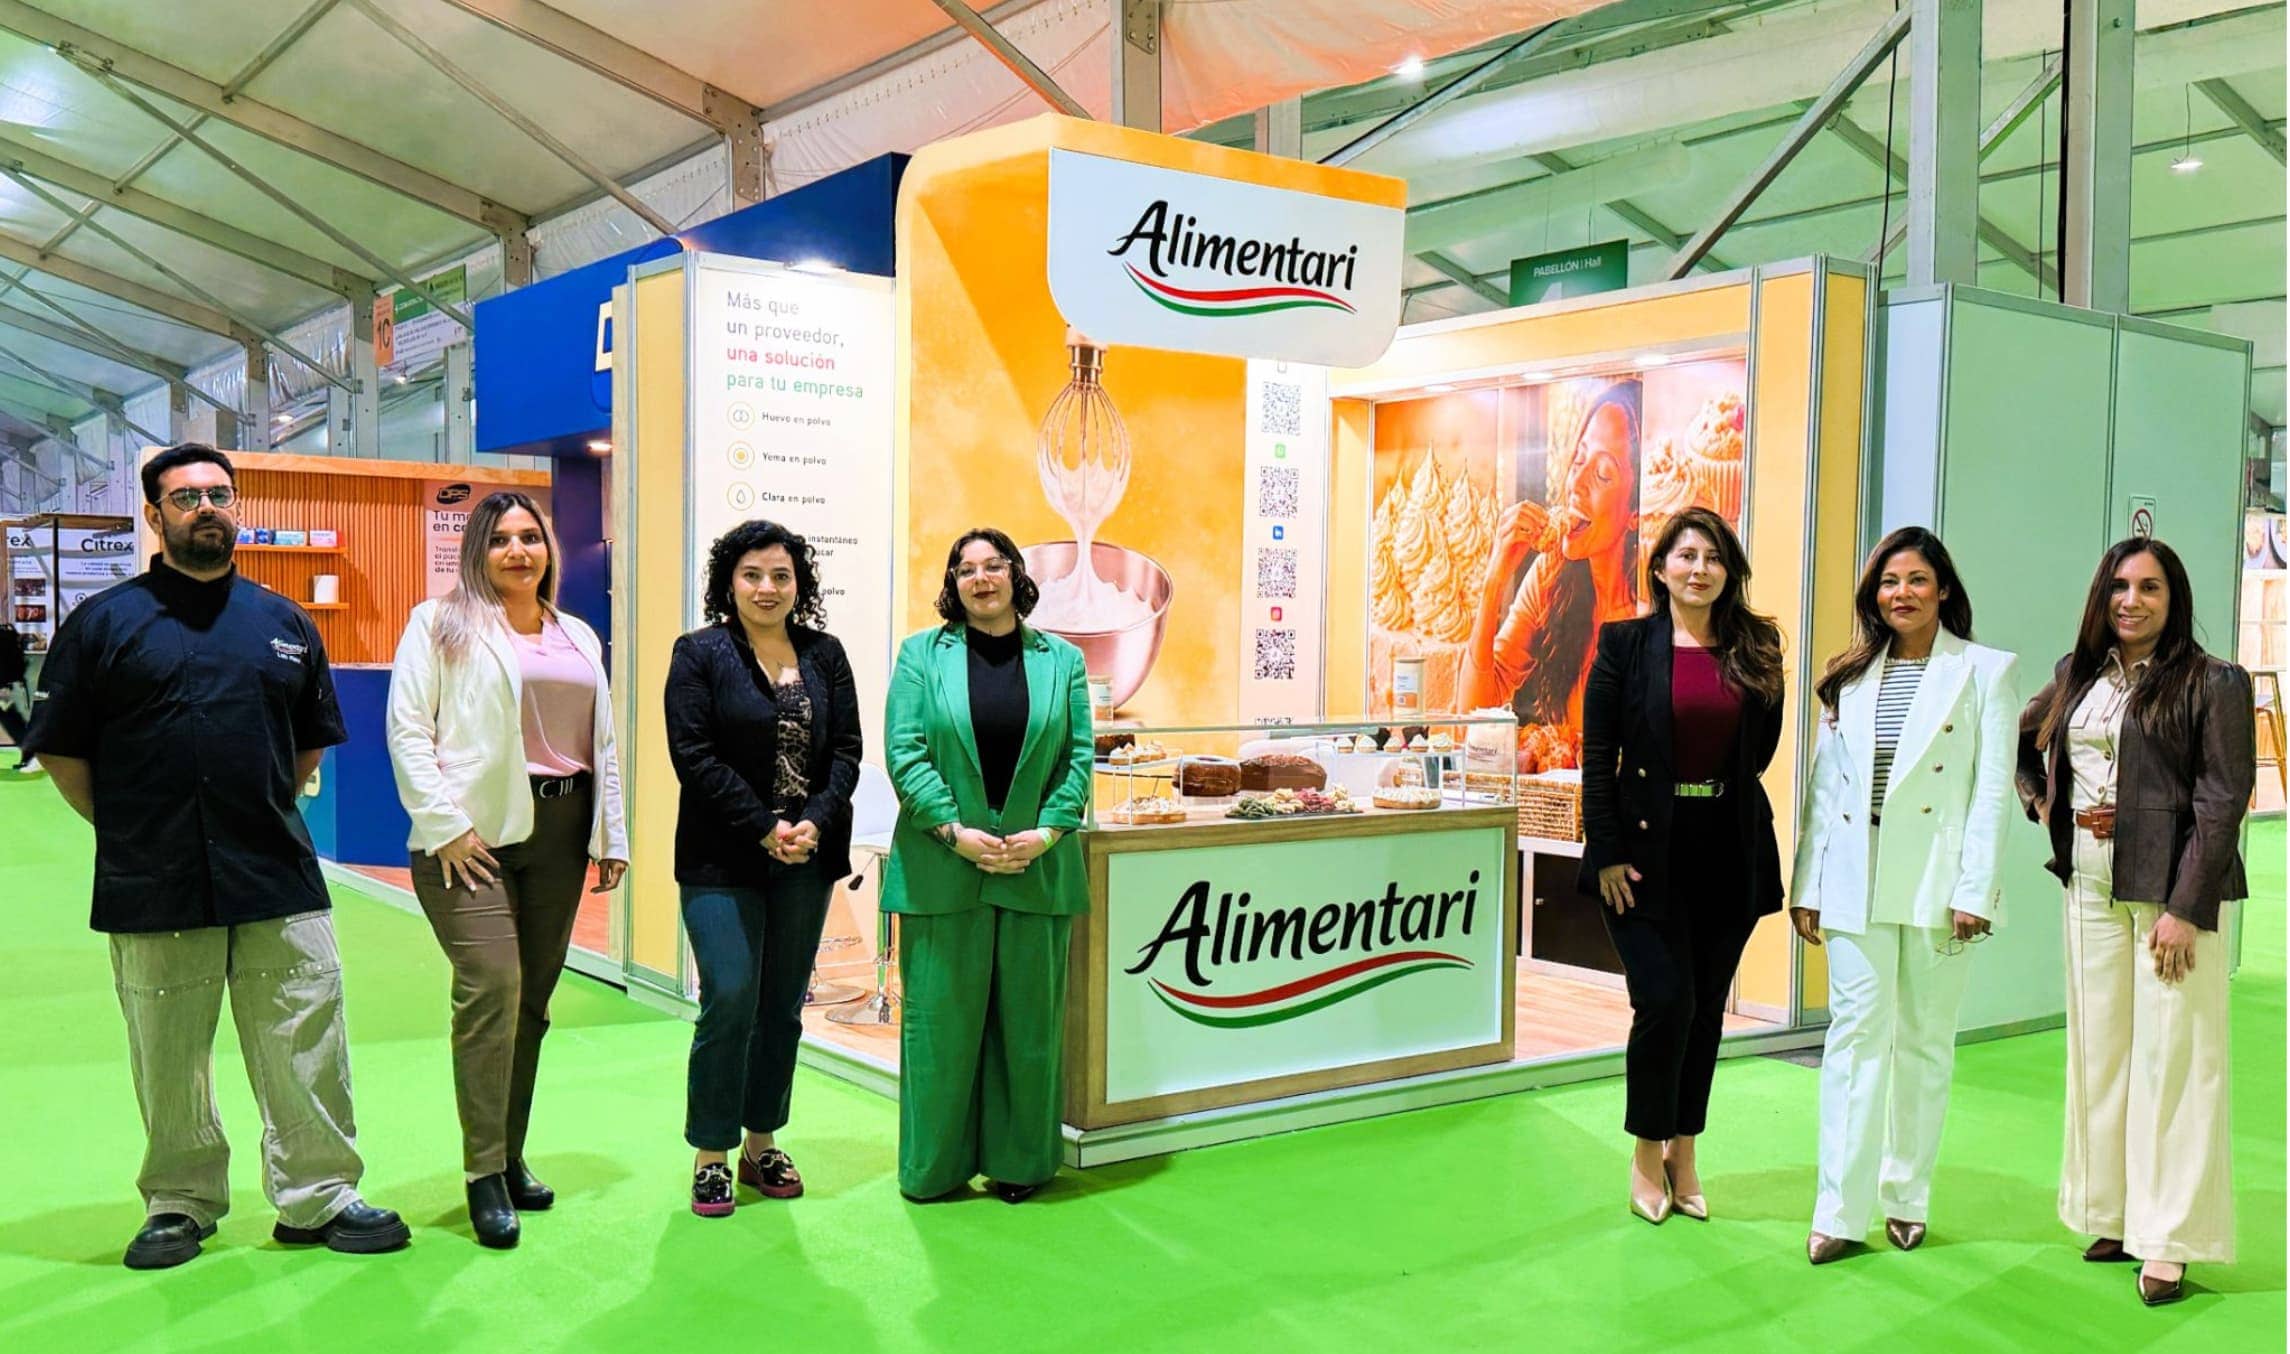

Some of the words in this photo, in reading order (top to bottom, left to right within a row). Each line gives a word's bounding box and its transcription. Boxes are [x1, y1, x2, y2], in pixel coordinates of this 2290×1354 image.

[1107, 200, 1357, 290] Alimentari
[1585, 256, 1602, 268] Hall
[727, 291, 762, 310] Más
[768, 301, 799, 317] que
[727, 321, 747, 335] un
[754, 324, 844, 348] proveedor,
[727, 347, 758, 362] una
[765, 350, 835, 370] solución
[727, 374, 764, 390] para
[771, 376, 786, 391] tu
[793, 381, 863, 398] empresa
[762, 412, 791, 423] Huevo
[793, 415, 804, 424] en
[807, 416, 831, 426] polvo
[762, 452, 786, 463] Yema
[789, 455, 800, 463] en
[803, 456, 827, 466] polvo
[762, 491, 785, 502] Clara
[788, 494, 799, 502] en
[802, 495, 826, 505] polvo
[433, 511, 449, 521] Tu
[433, 523, 449, 532] en
[81, 538, 134, 553] Citrex
[1124, 870, 1479, 986] Alimentari
